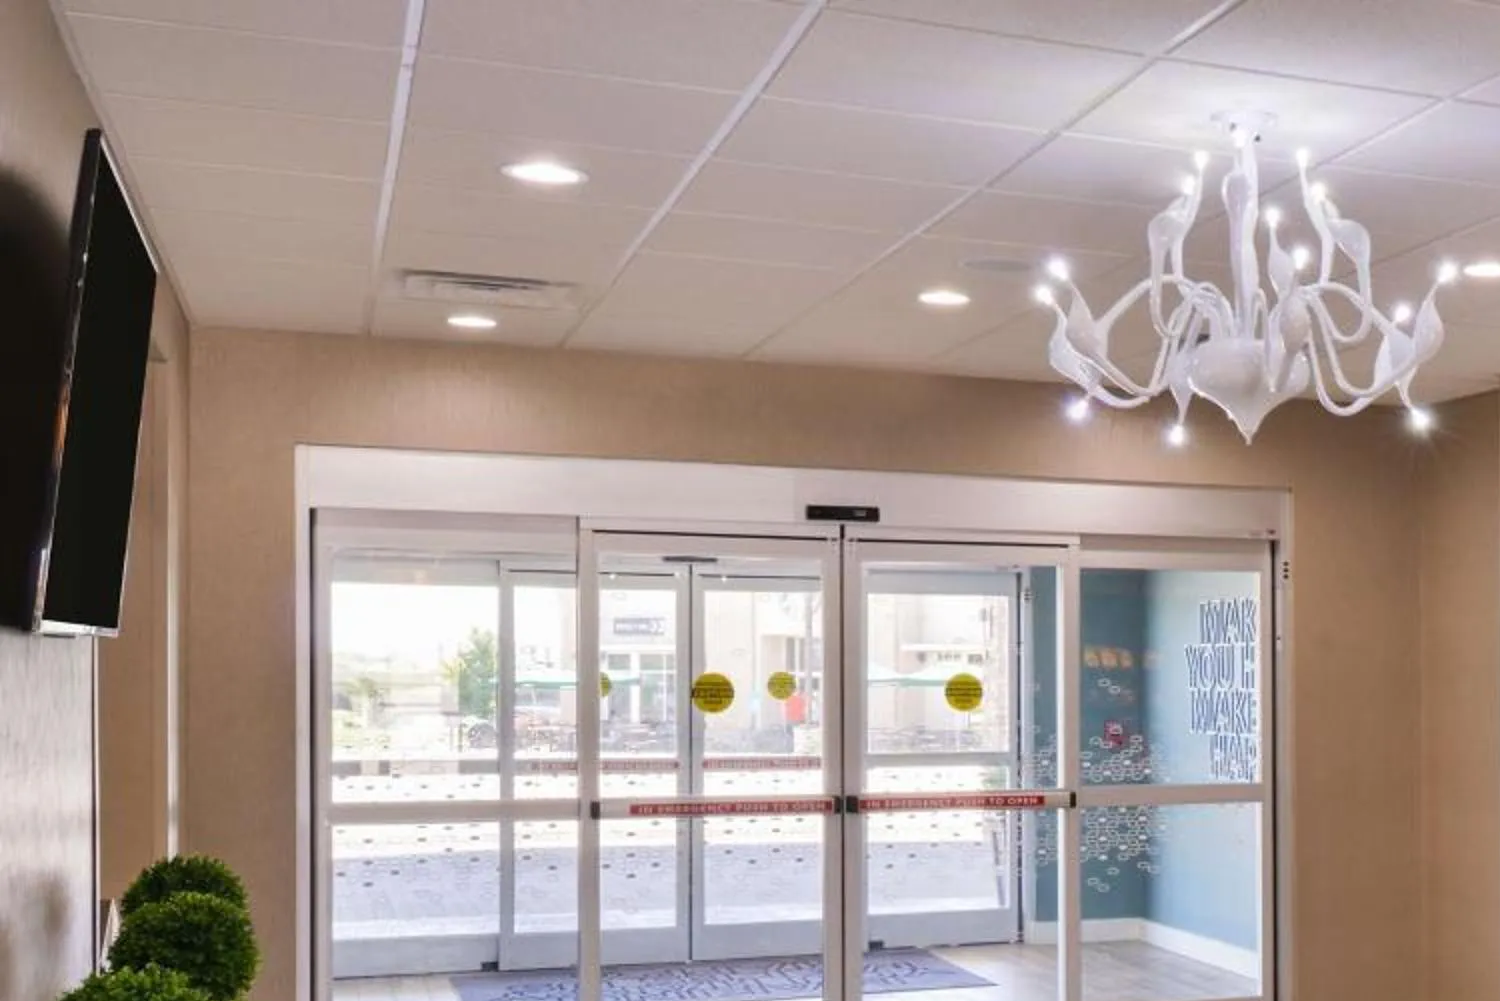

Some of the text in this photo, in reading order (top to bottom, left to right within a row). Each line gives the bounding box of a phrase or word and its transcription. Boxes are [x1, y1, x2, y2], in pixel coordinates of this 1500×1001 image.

[1185, 645, 1235, 688] YOU
[736, 803, 769, 813] PUSH
[773, 802, 788, 812] TO
[790, 801, 826, 812] OPEN
[956, 798, 985, 808] PUSH
[989, 797, 1005, 806] TO
[1007, 796, 1038, 805] OPEN
